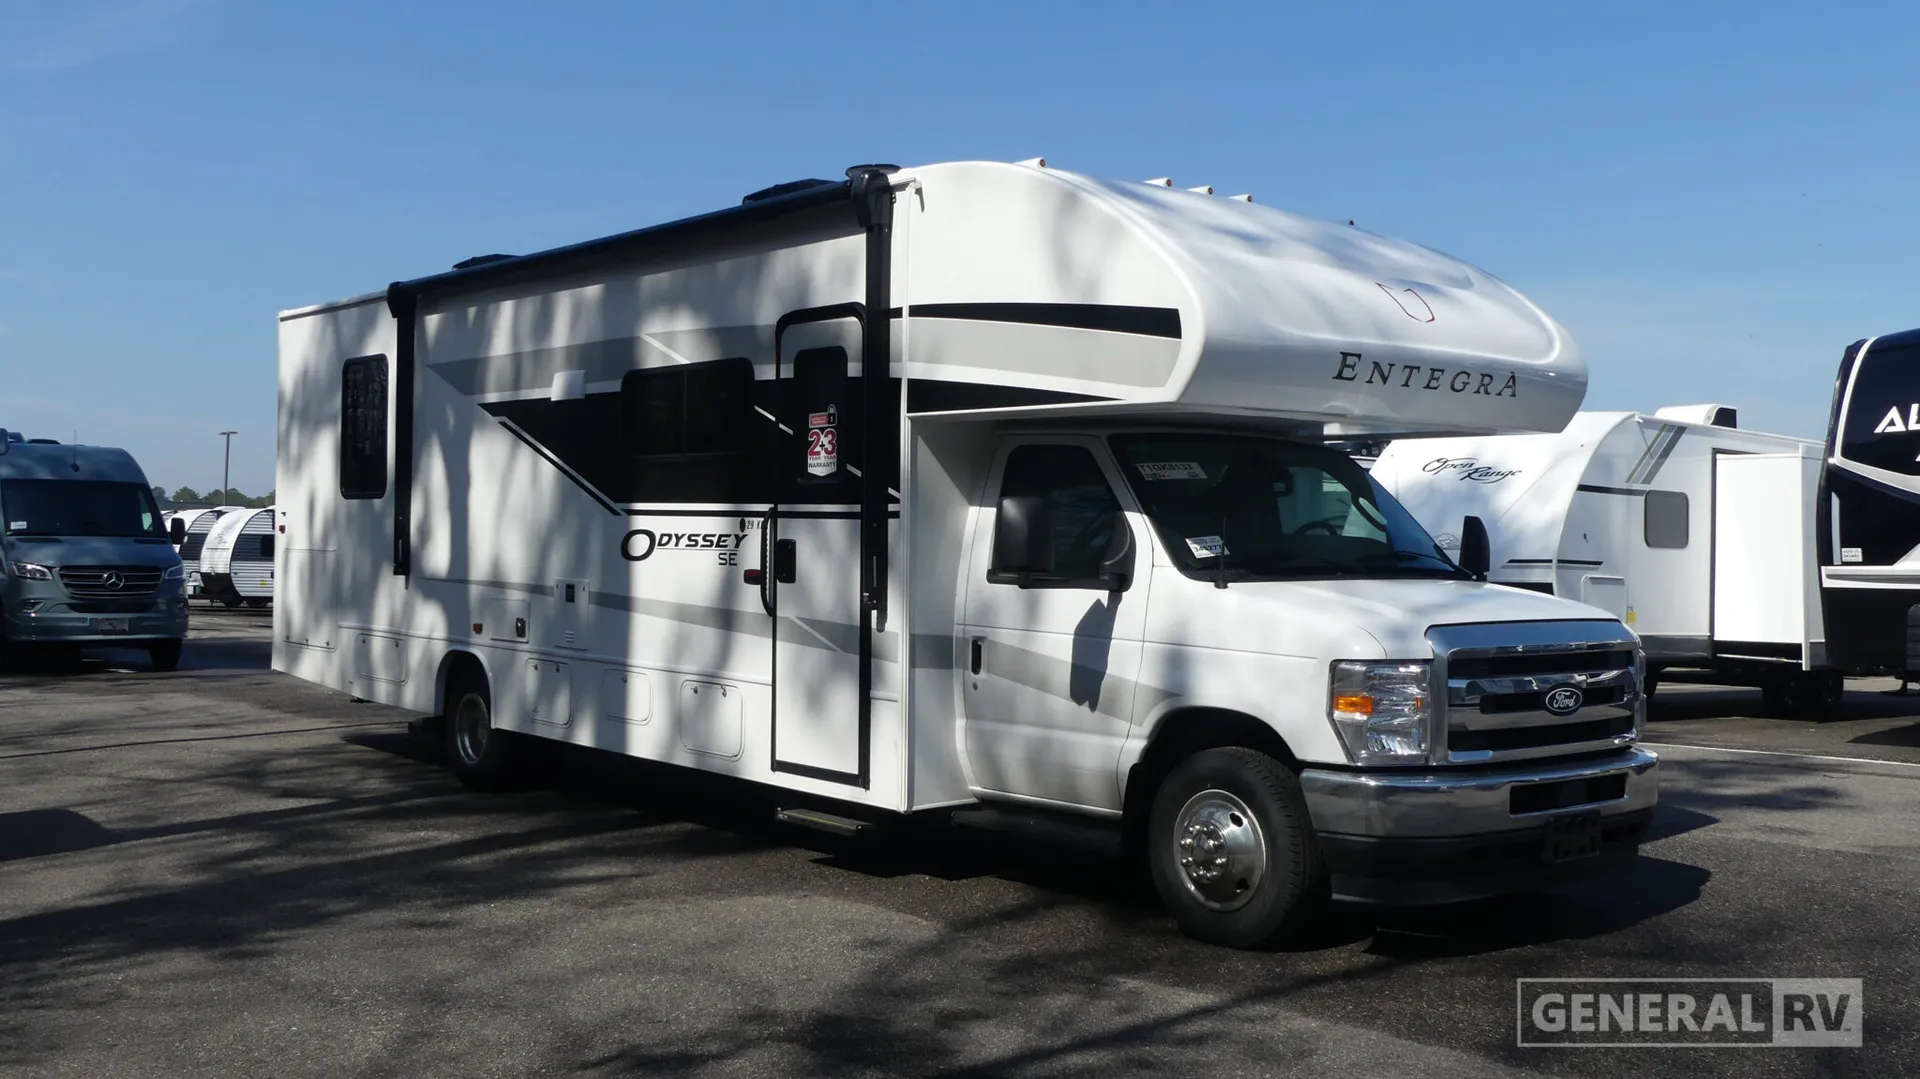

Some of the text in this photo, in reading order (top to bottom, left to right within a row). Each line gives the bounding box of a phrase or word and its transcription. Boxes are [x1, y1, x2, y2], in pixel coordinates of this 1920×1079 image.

[1332, 351, 1518, 397] ENTEGRA
[1422, 457, 1522, 485] Open Range
[620, 529, 749, 562] ODYSSEY
[718, 552, 738, 566] SE
[1553, 692, 1576, 707] Ford
